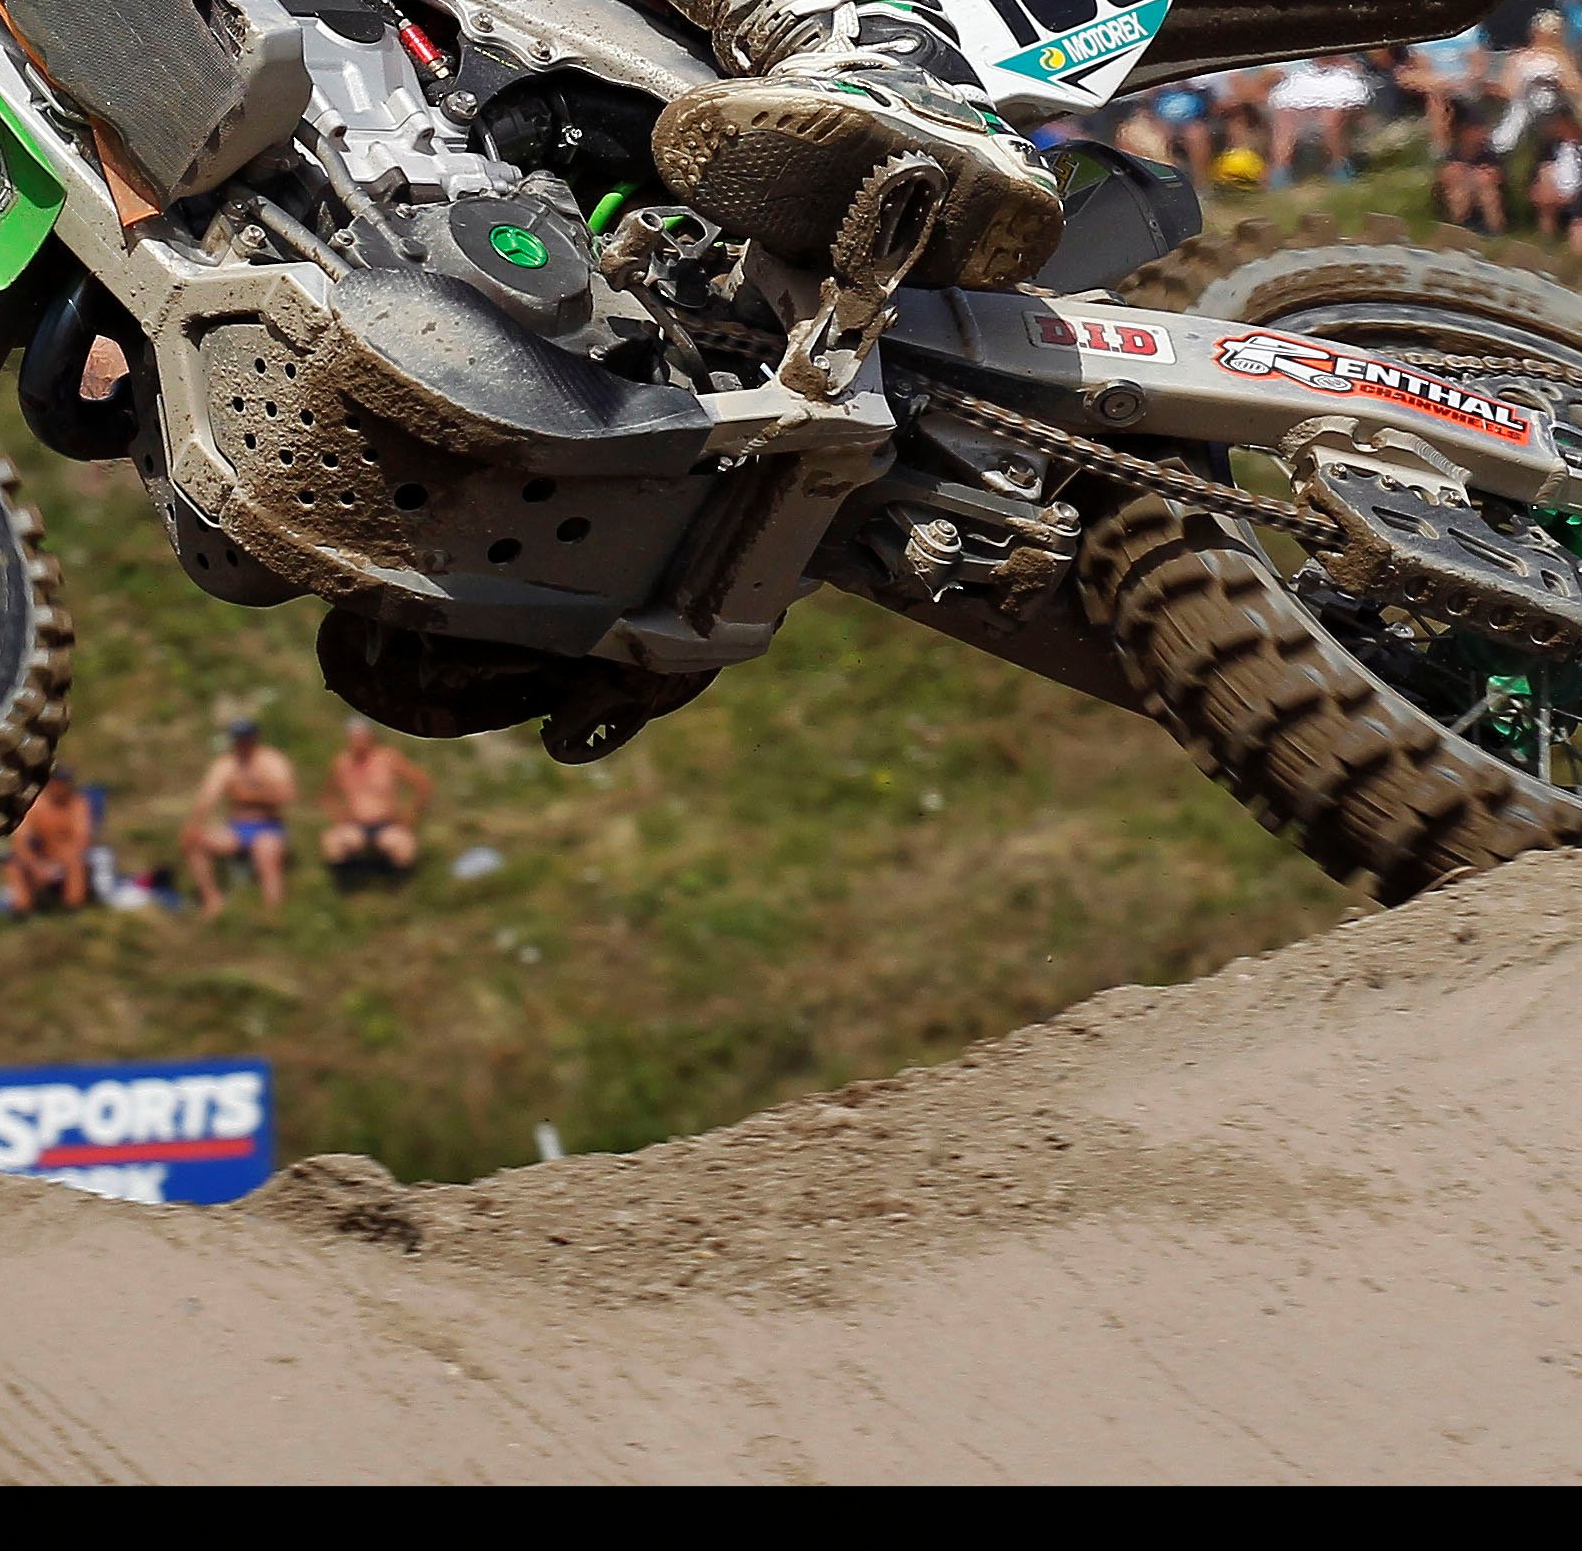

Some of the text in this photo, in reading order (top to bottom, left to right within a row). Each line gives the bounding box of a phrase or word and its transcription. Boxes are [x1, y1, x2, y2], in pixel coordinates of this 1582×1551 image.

[1066, 12, 1149, 64] MOTOREX
[1221, 335, 1525, 431] RENTHAL
[1358, 383, 1524, 442] CHAINWHEELS
